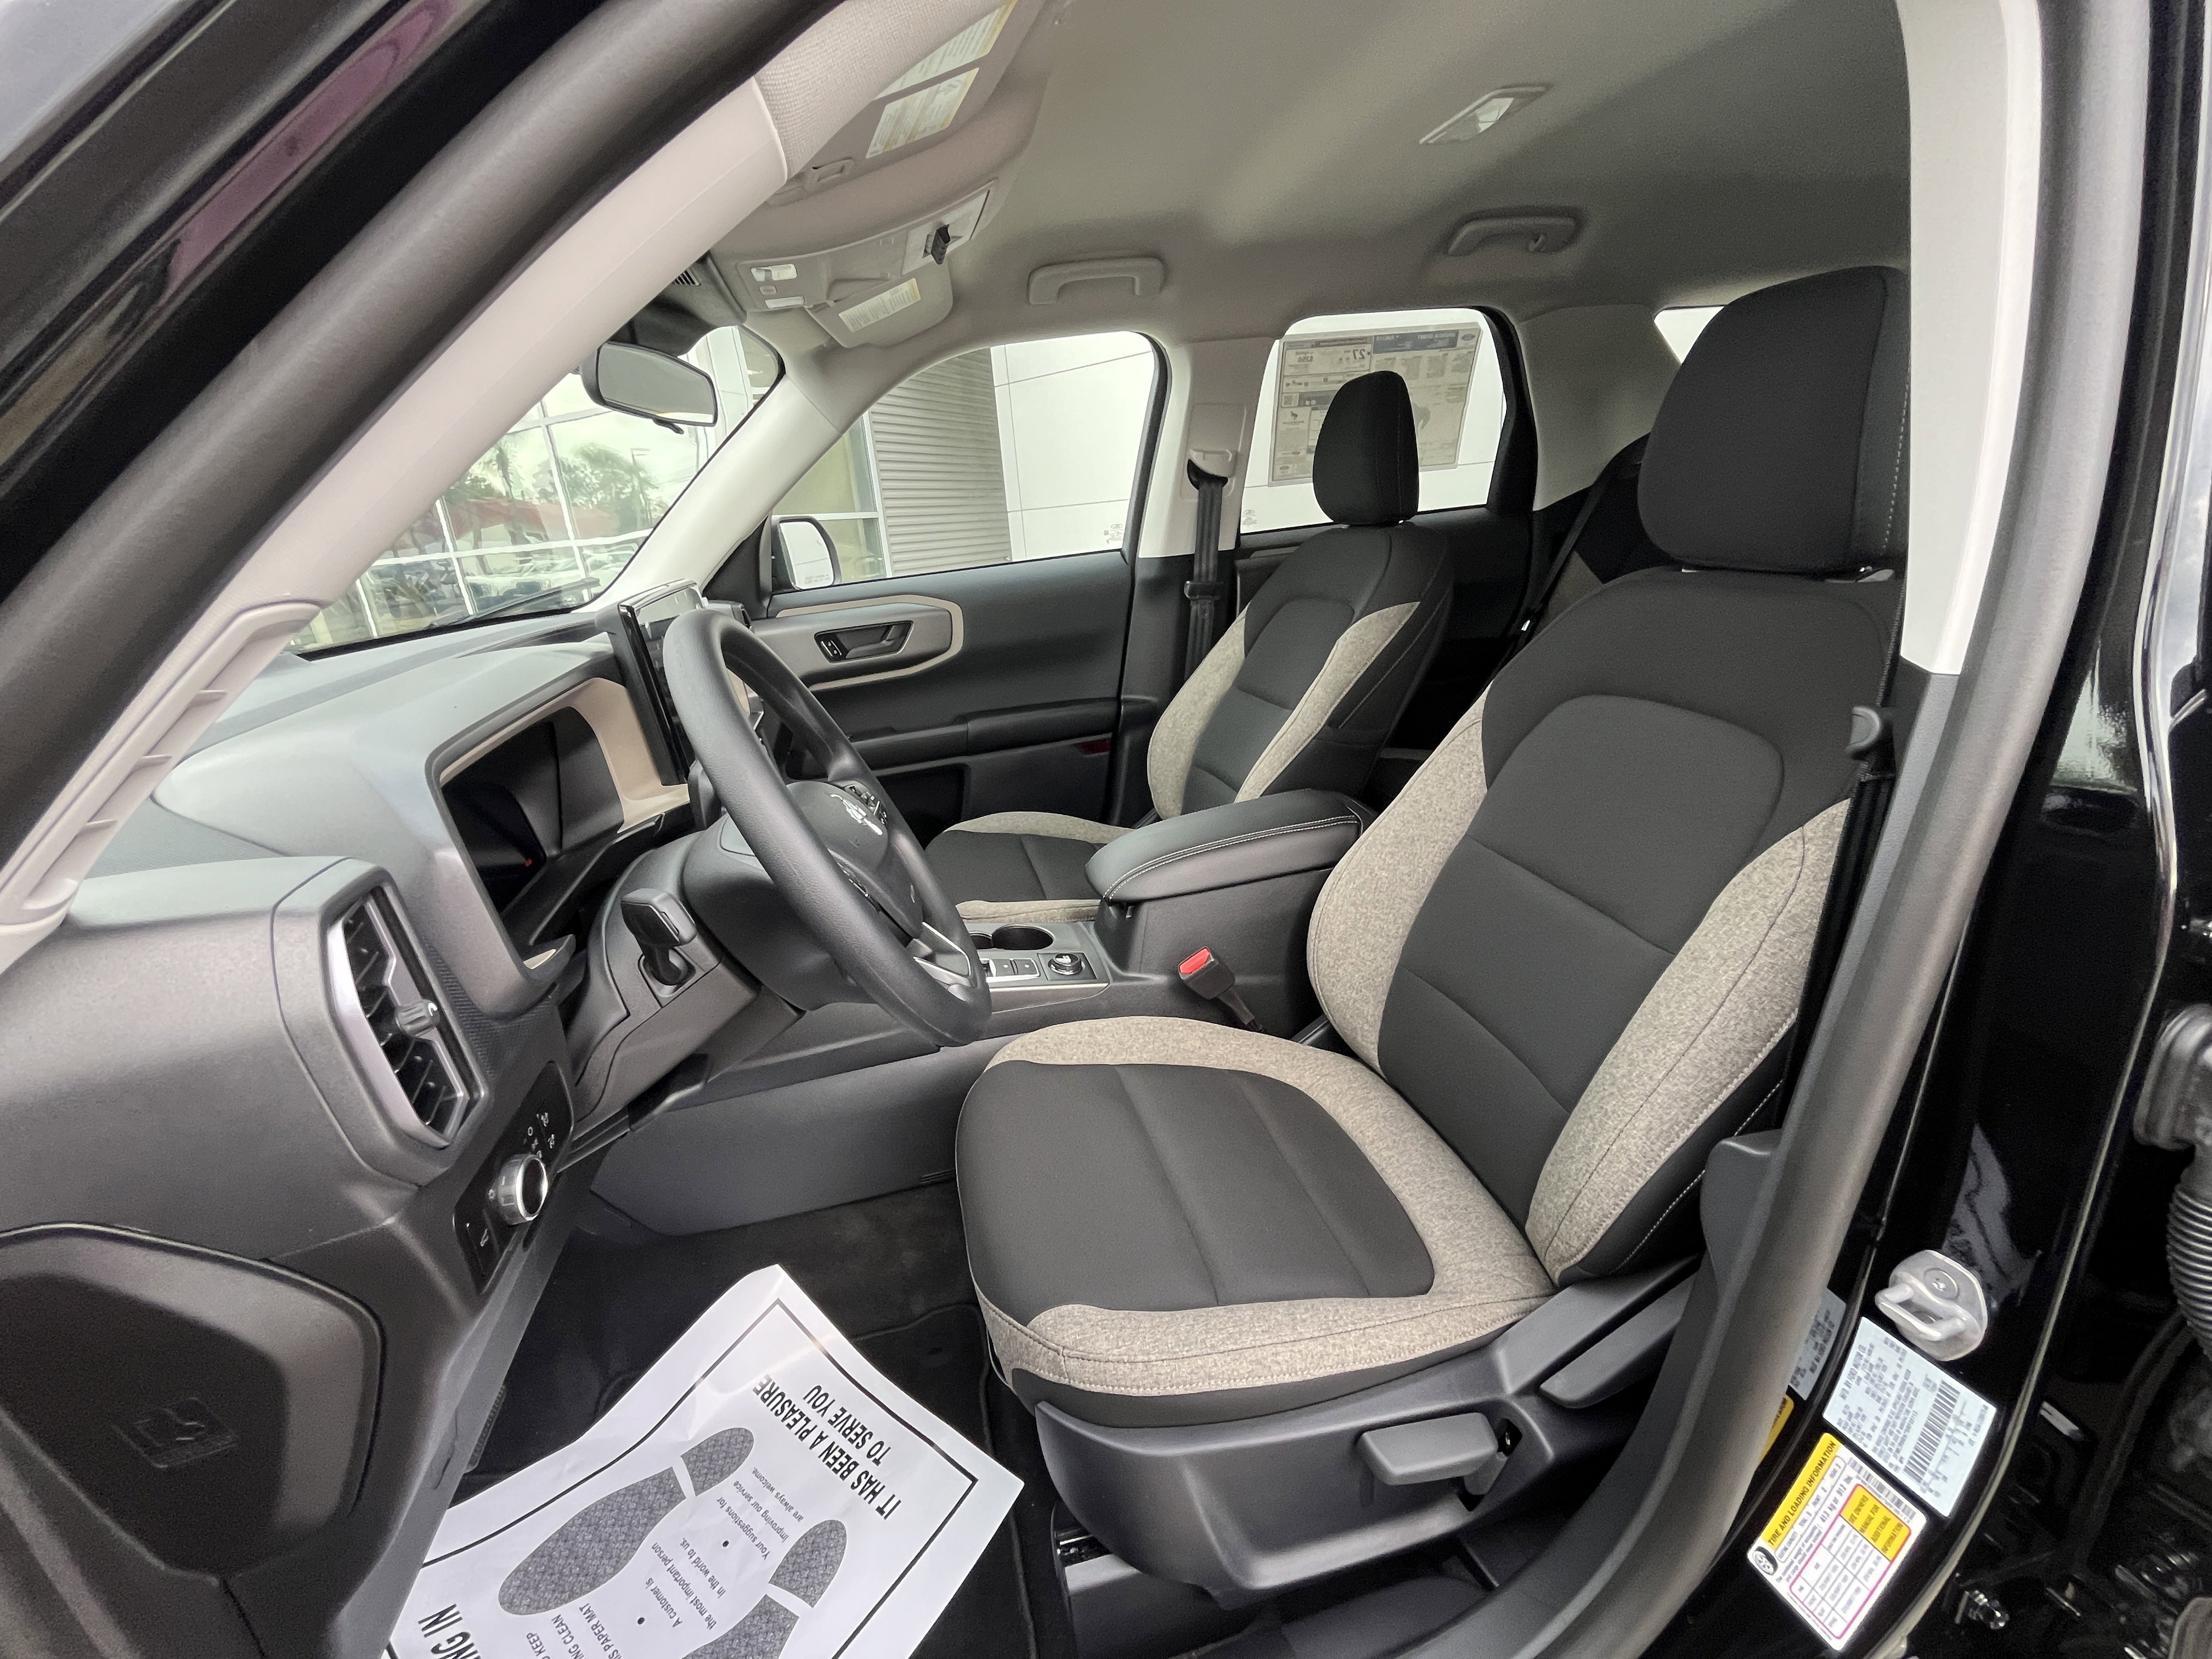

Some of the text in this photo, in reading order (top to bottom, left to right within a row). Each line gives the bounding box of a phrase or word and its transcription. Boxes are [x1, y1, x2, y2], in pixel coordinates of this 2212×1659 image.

[752, 1373, 901, 1520] IT HAS BEEN A PLEASURE
[802, 1385, 891, 1466] TO SERVE YOU
[733, 1481, 789, 1543] improving our service
[752, 1467, 804, 1522] are always welcome.
[1767, 1528, 1782, 1547] TIRE
[1777, 1513, 1791, 1531] AND
[1786, 1484, 1810, 1516] LOADING
[1804, 1440, 1837, 1487] INFORMATION
[716, 1497, 770, 1561] Your suggestions for
[651, 1542, 716, 1630] the most important person
[680, 1537, 726, 1599] in the world to us.
[417, 1603, 481, 1659] NG IN
[551, 1614, 574, 1645] CLEAN
[579, 1602, 597, 1623] MAT
[645, 1577, 683, 1628] A customer is
[526, 1632, 546, 1657] KEEP
[590, 1620, 614, 1652] PAPER
